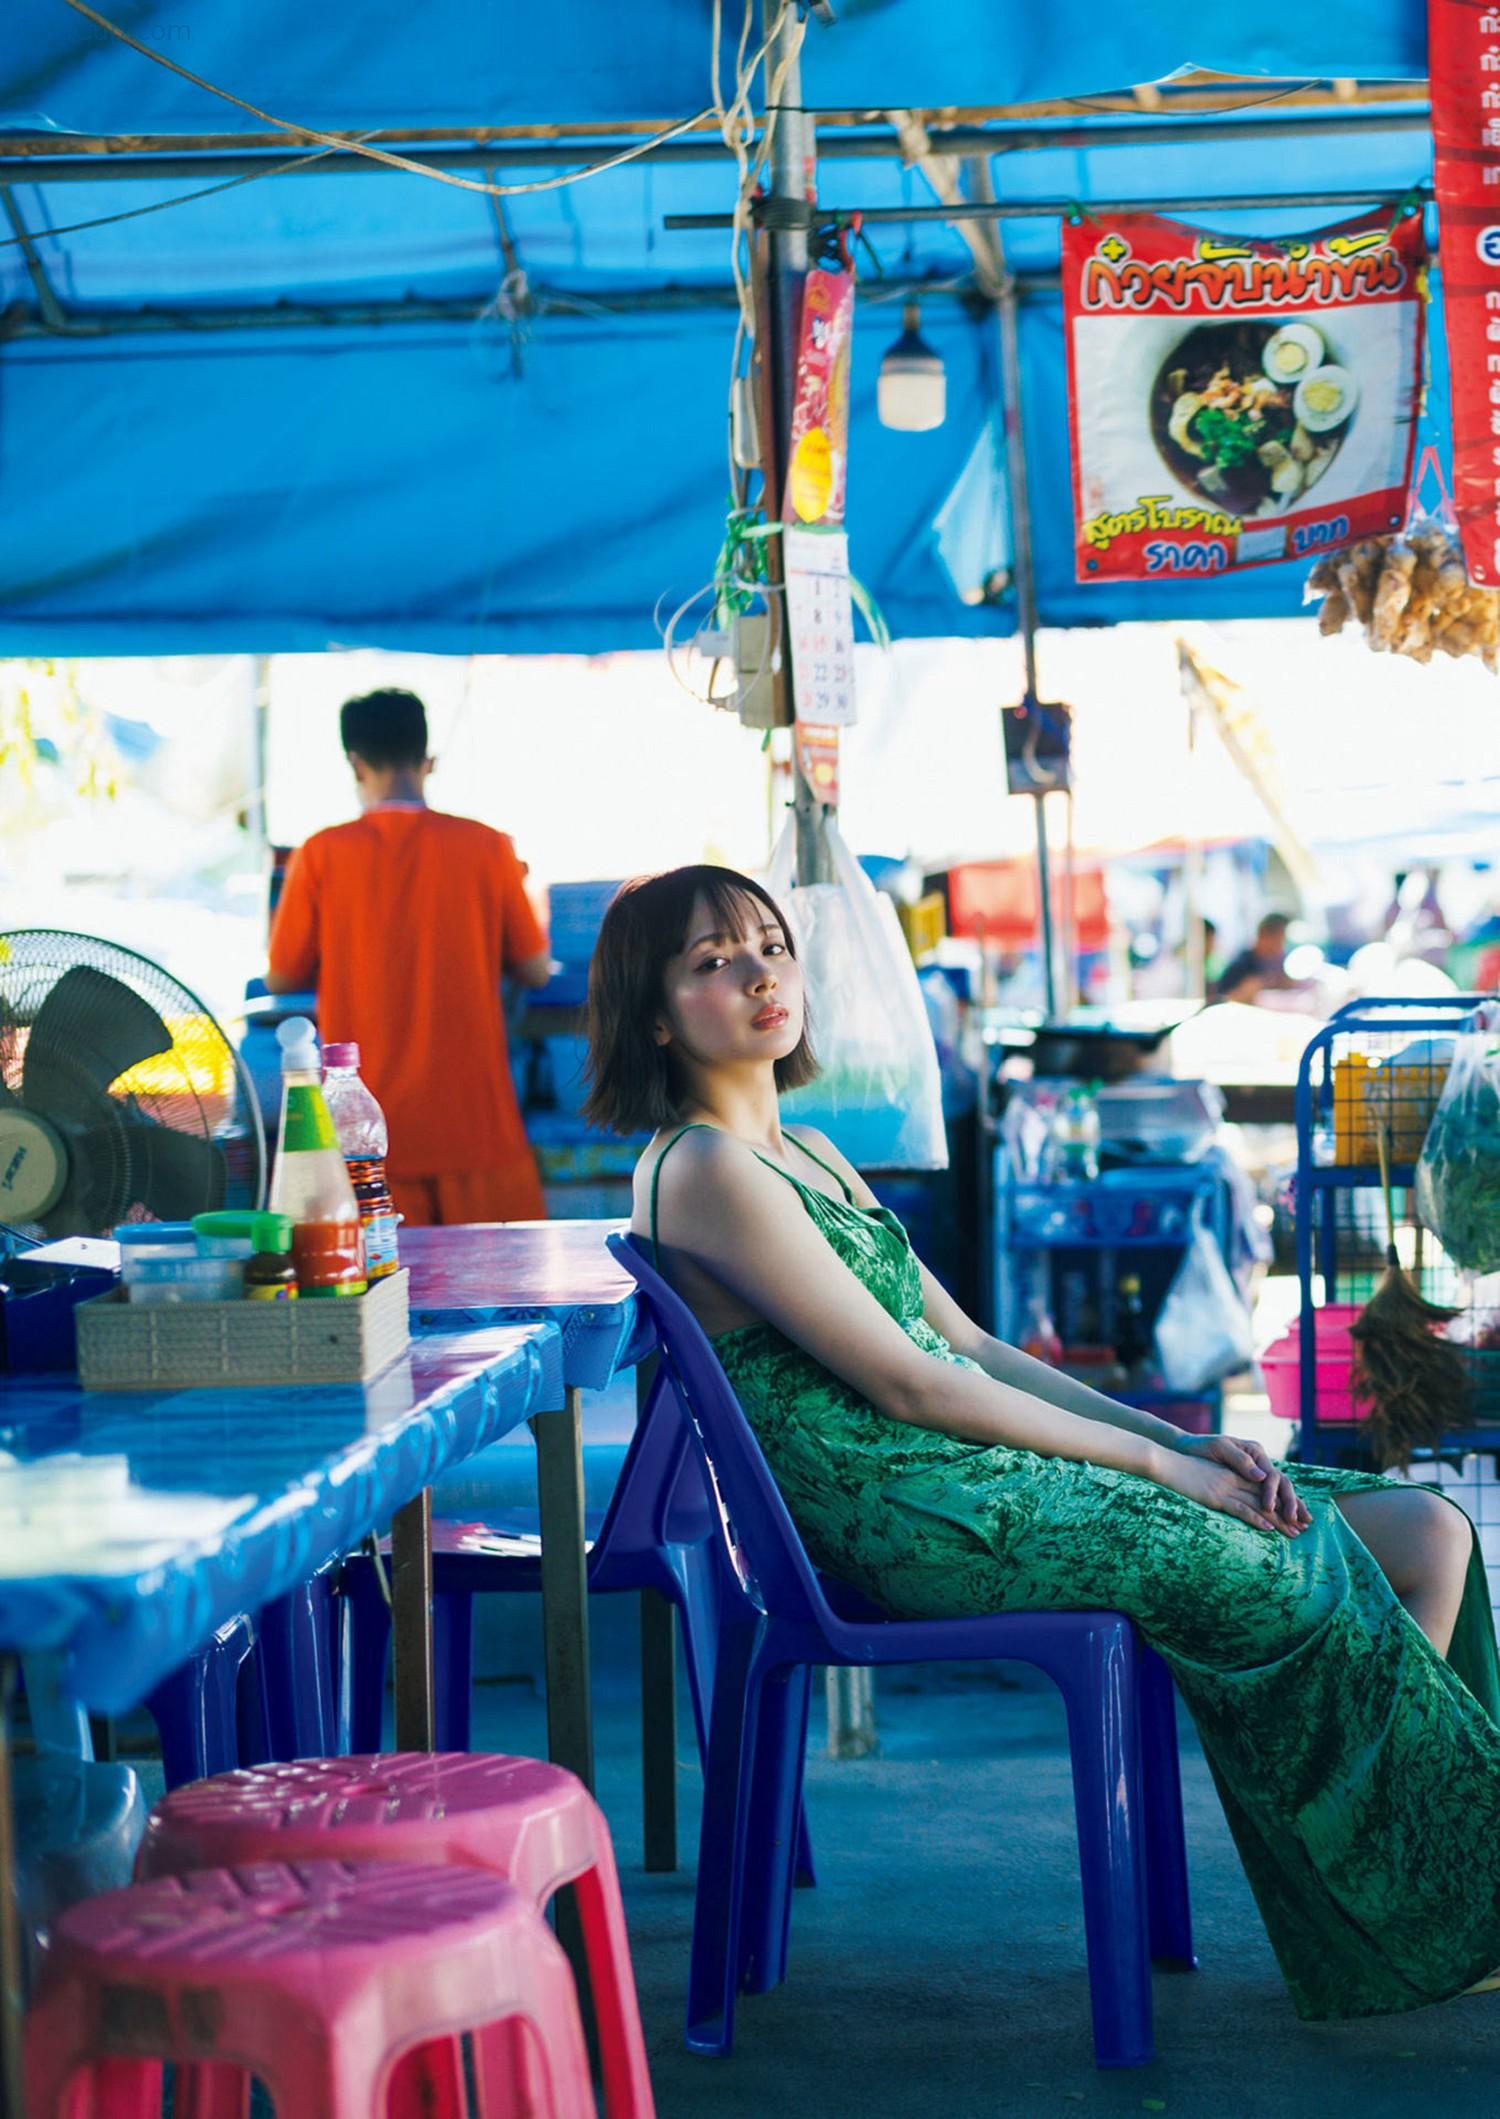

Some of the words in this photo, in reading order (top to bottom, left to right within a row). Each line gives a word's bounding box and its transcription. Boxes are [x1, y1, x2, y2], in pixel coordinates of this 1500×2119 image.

[1083, 495, 1243, 551] สูตรโบราณ
[1145, 541, 1227, 571] ราคา
[1293, 514, 1349, 553] บาท
